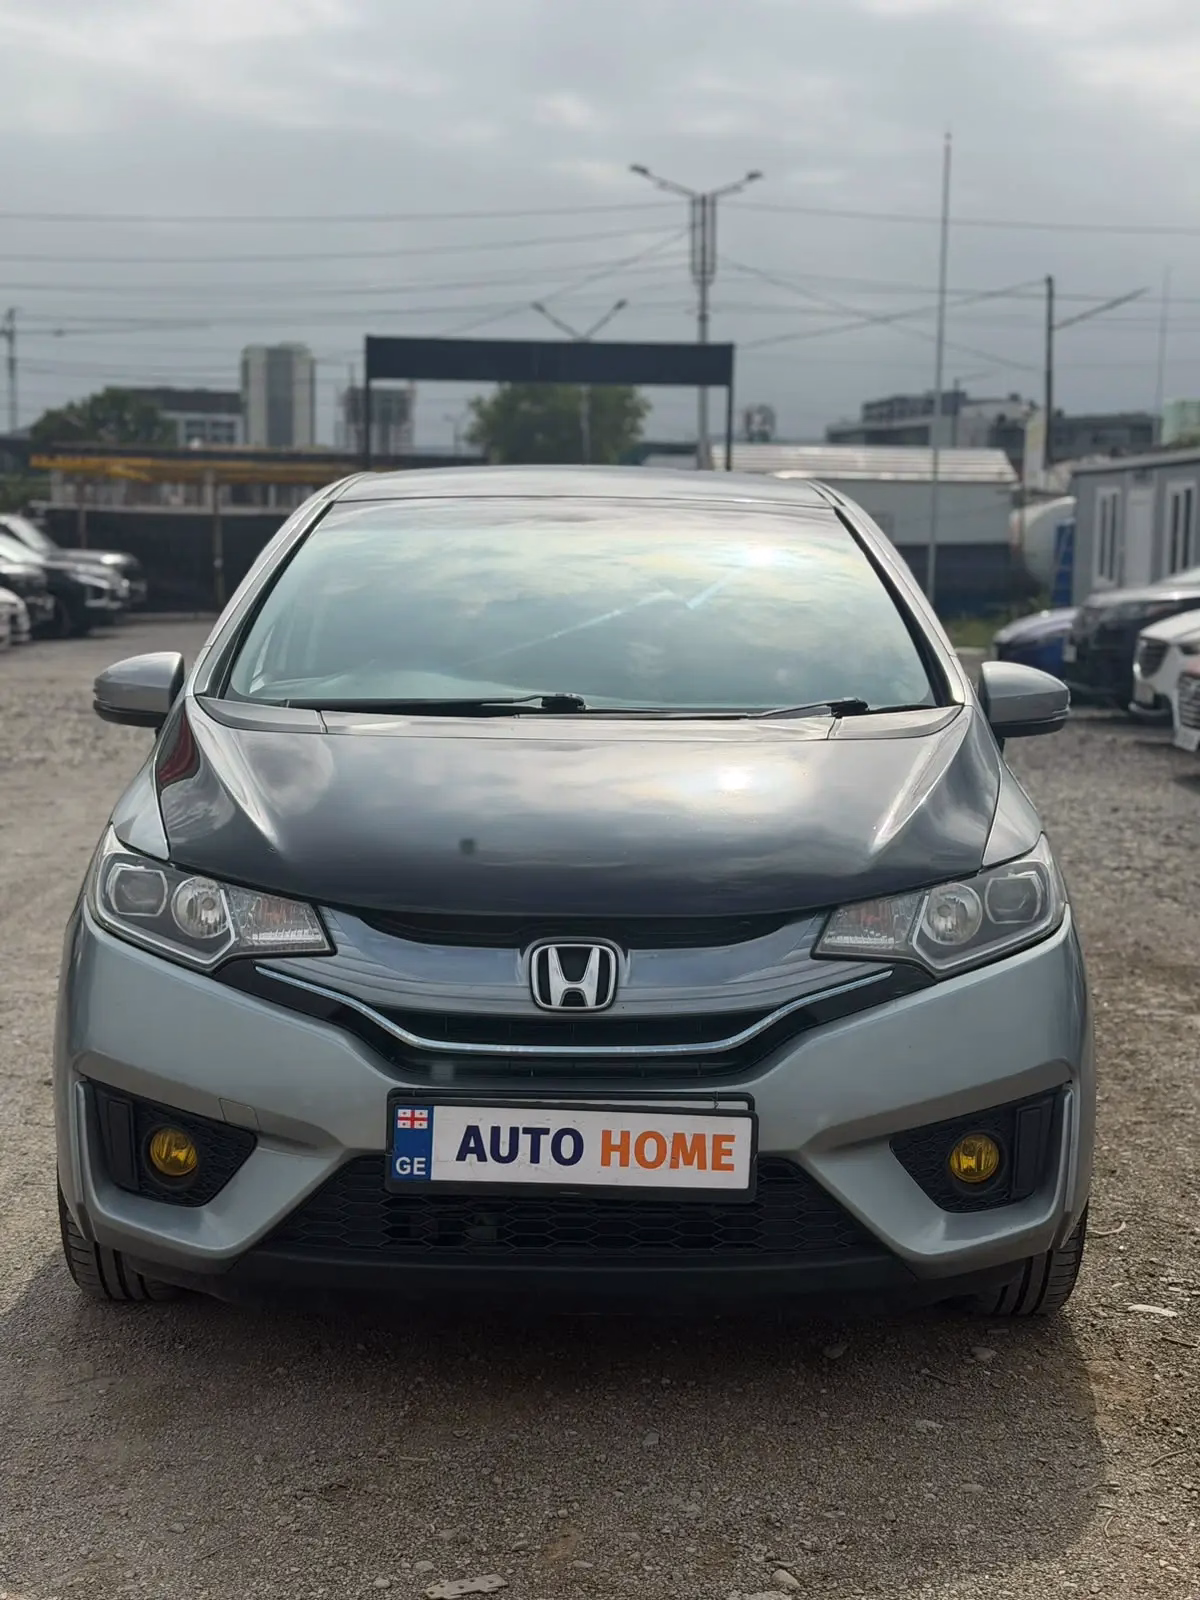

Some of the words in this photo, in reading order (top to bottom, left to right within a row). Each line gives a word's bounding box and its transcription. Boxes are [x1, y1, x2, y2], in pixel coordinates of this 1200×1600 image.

[455, 1124, 585, 1167] AUTO
[601, 1129, 737, 1172] HOME
[395, 1156, 427, 1176] GE
